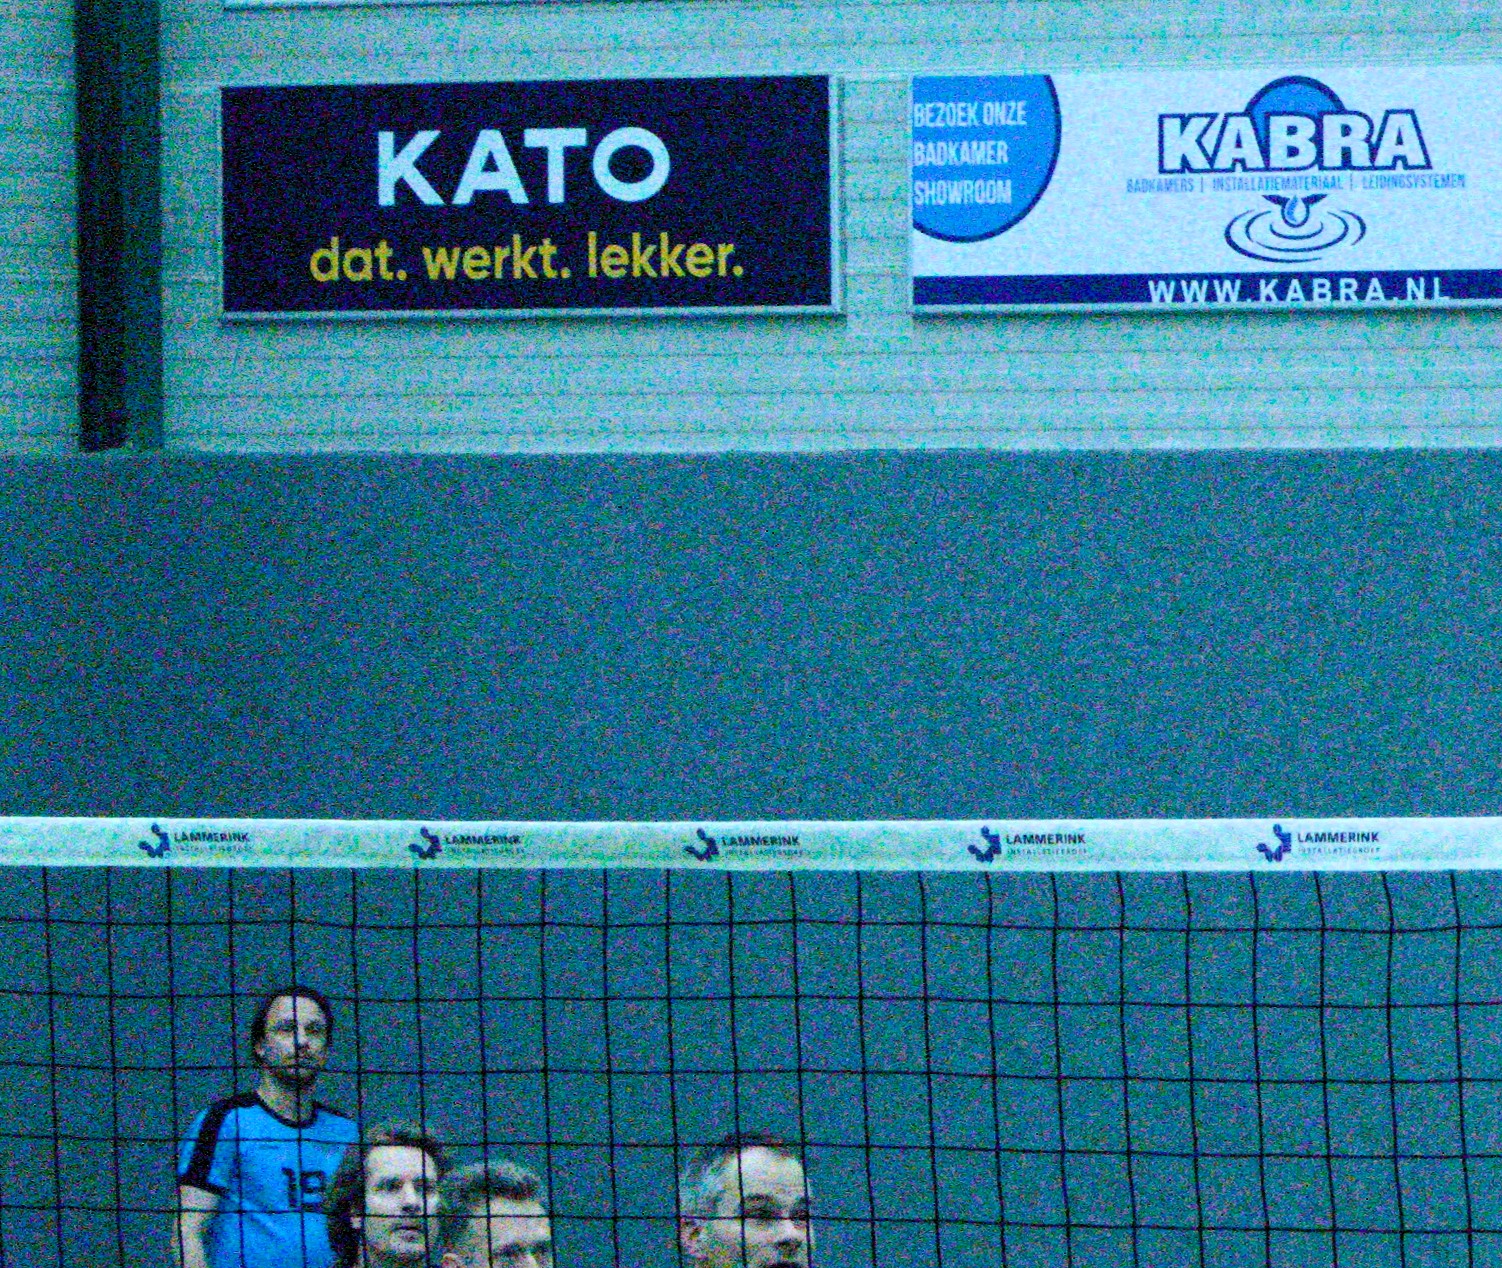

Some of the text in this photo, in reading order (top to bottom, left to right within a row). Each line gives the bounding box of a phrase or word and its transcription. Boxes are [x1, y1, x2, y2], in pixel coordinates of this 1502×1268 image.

[913, 101, 1027, 128] BEZOEK ONZE
[1159, 109, 1433, 174] KABRA
[377, 126, 671, 207] KATO
[913, 142, 1009, 167] BADKAMER
[913, 180, 1012, 206] SHOWROOM
[1126, 178, 1195, 193] BADKAMERS
[1212, 175, 1344, 192] INSTALLATIEMATERIAAL
[309, 231, 744, 282] dat. werkt. lekker.
[1148, 277, 1450, 304] WWW.KABRA.NL
[174, 832, 250, 842] LAMMERINK
[444, 835, 521, 844] LAMMERINK
[721, 836, 800, 846] LAMMERINK
[1006, 833, 1086, 845] LAMMERINK
[1297, 832, 1379, 843] LAMMERINK
